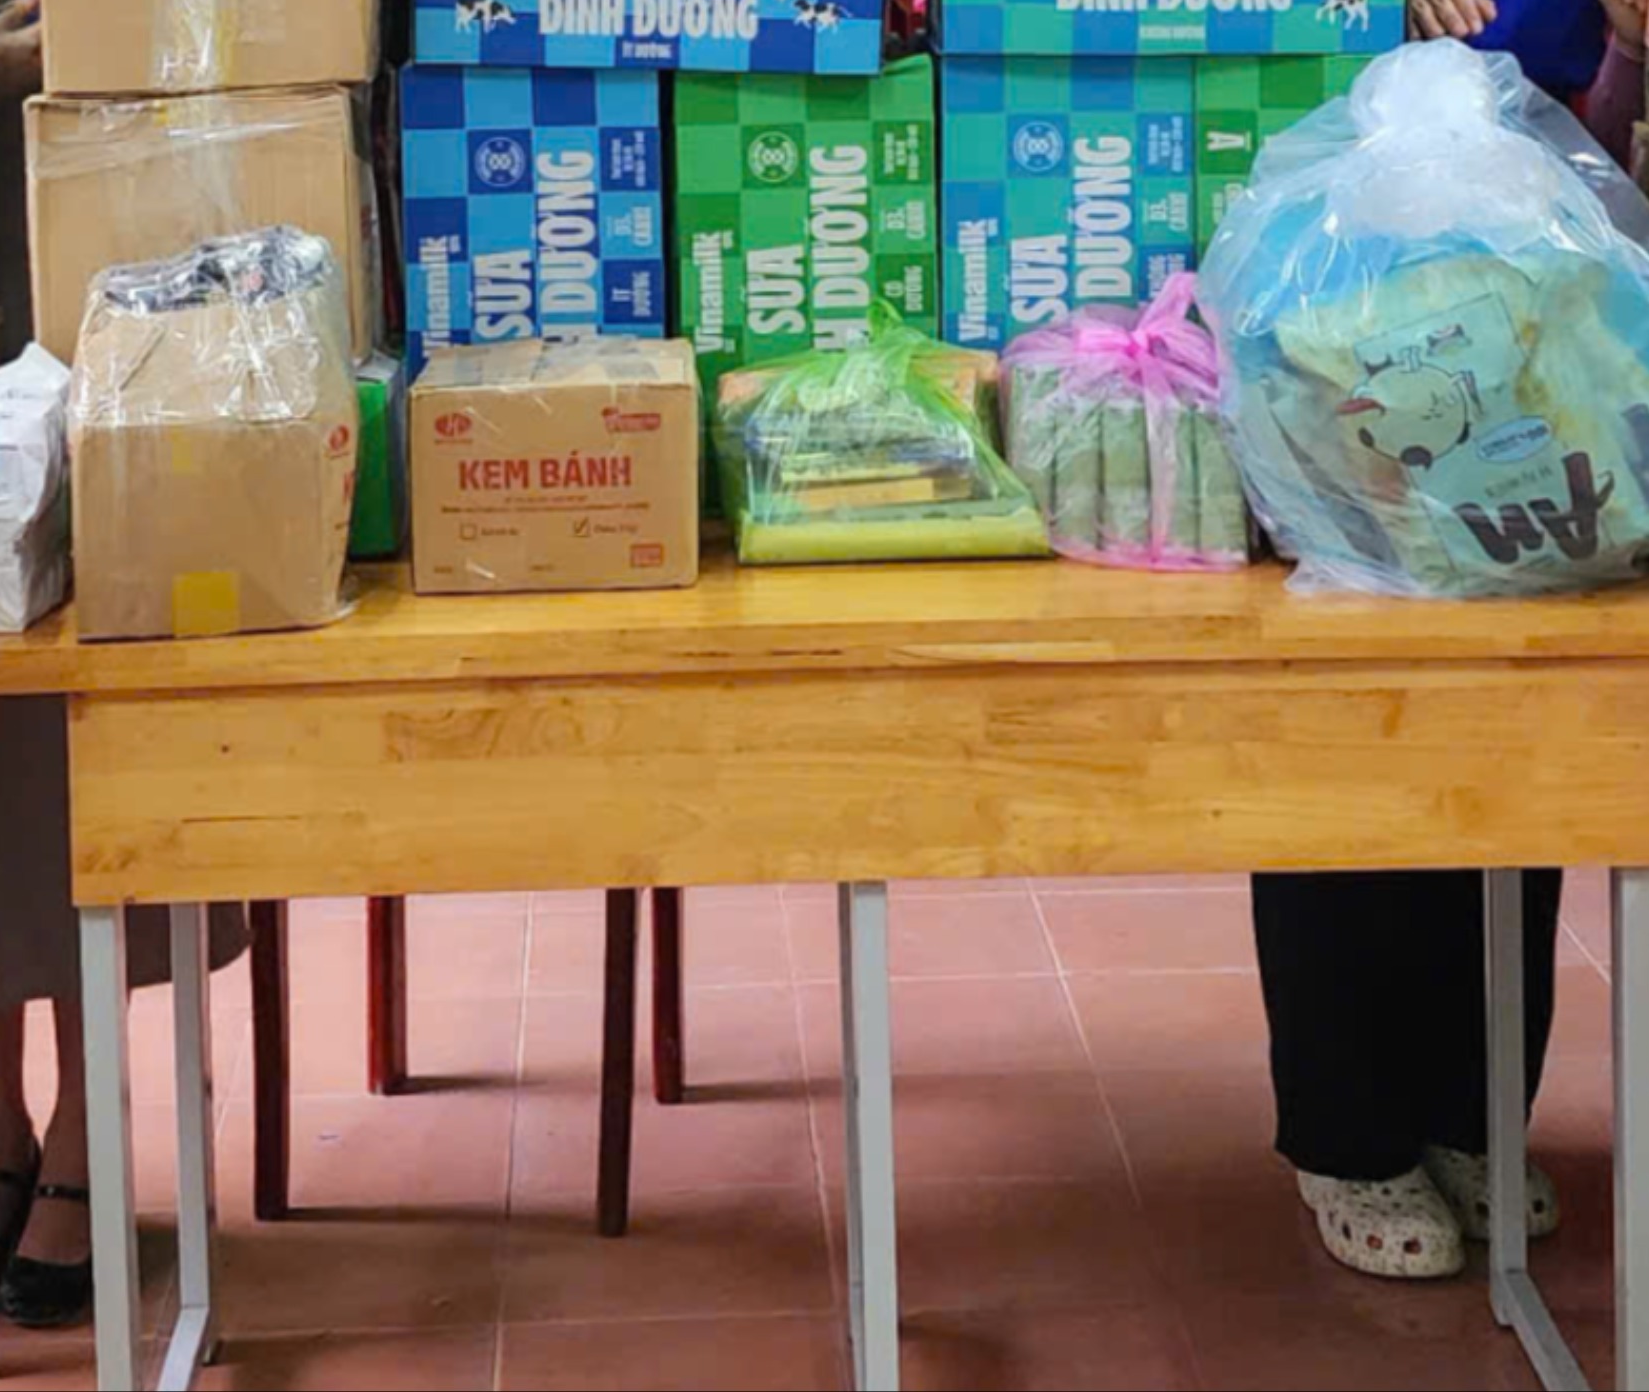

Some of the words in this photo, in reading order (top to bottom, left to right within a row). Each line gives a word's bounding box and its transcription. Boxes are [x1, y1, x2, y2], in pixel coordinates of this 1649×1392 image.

[531, 150, 598, 314] DƯỠNG
[803, 144, 870, 309] DƯỠNG
[1003, 233, 1069, 325] SỮA
[1067, 134, 1134, 299] DƯỠNG
[465, 248, 533, 338] SỮA
[692, 230, 724, 355] Vinamilk
[740, 243, 806, 335] SỮA
[957, 217, 989, 344] Vinamilk
[458, 459, 530, 491] KEM
[539, 449, 632, 489] BÁNH
